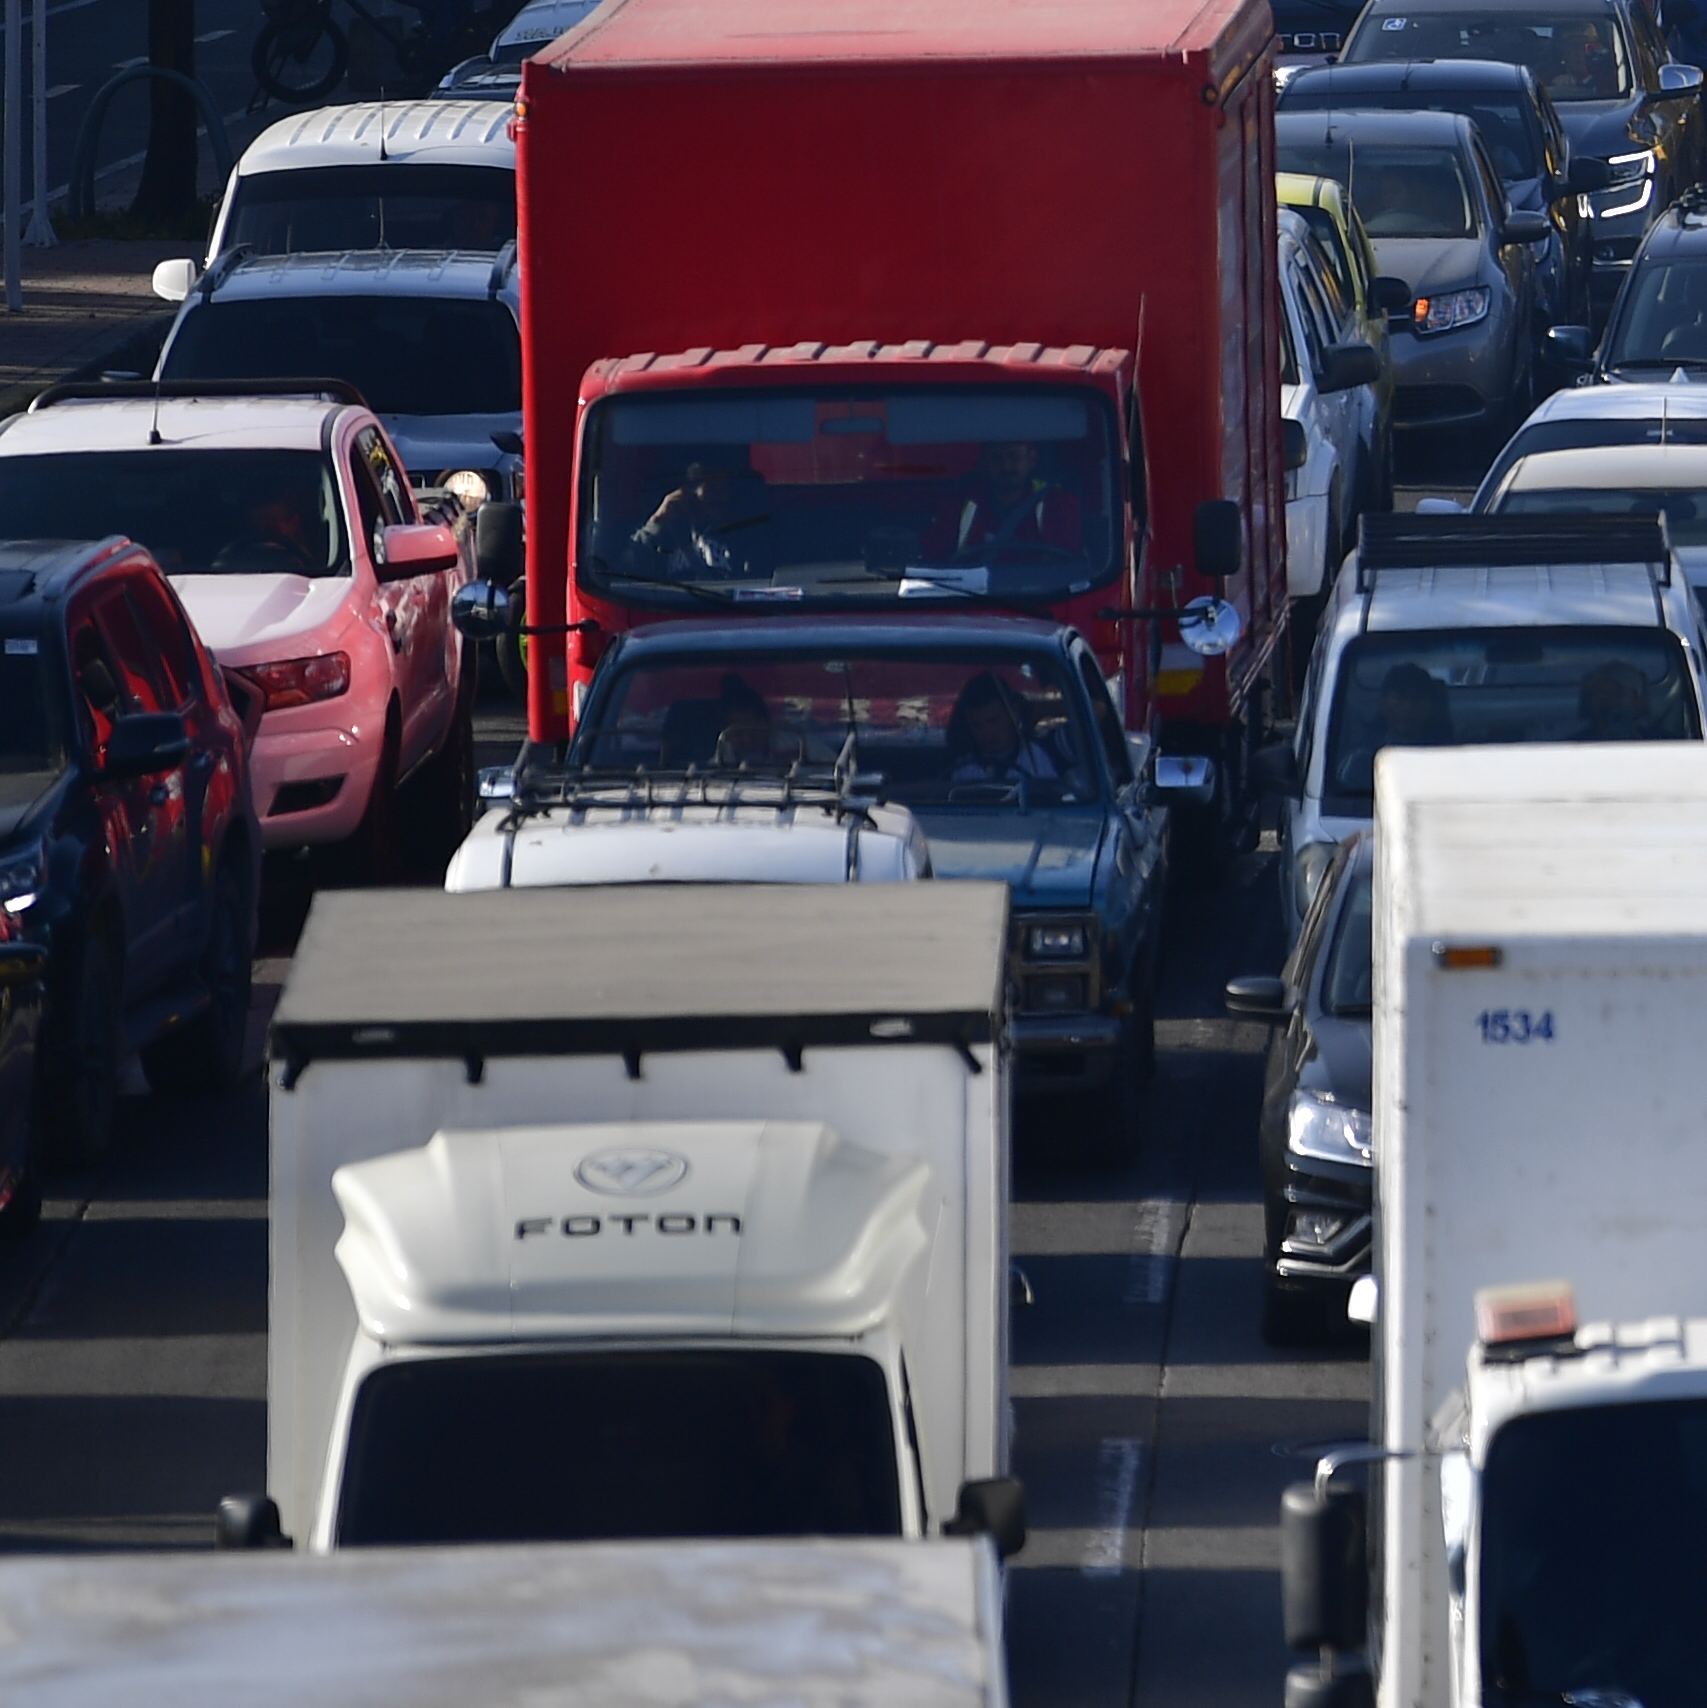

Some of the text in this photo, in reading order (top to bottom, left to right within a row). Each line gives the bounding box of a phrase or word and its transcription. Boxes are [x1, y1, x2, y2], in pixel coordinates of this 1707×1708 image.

[1279, 33, 1341, 50] TON
[1477, 1009, 1554, 1042] 1534
[515, 1214, 741, 1241] FOTON
